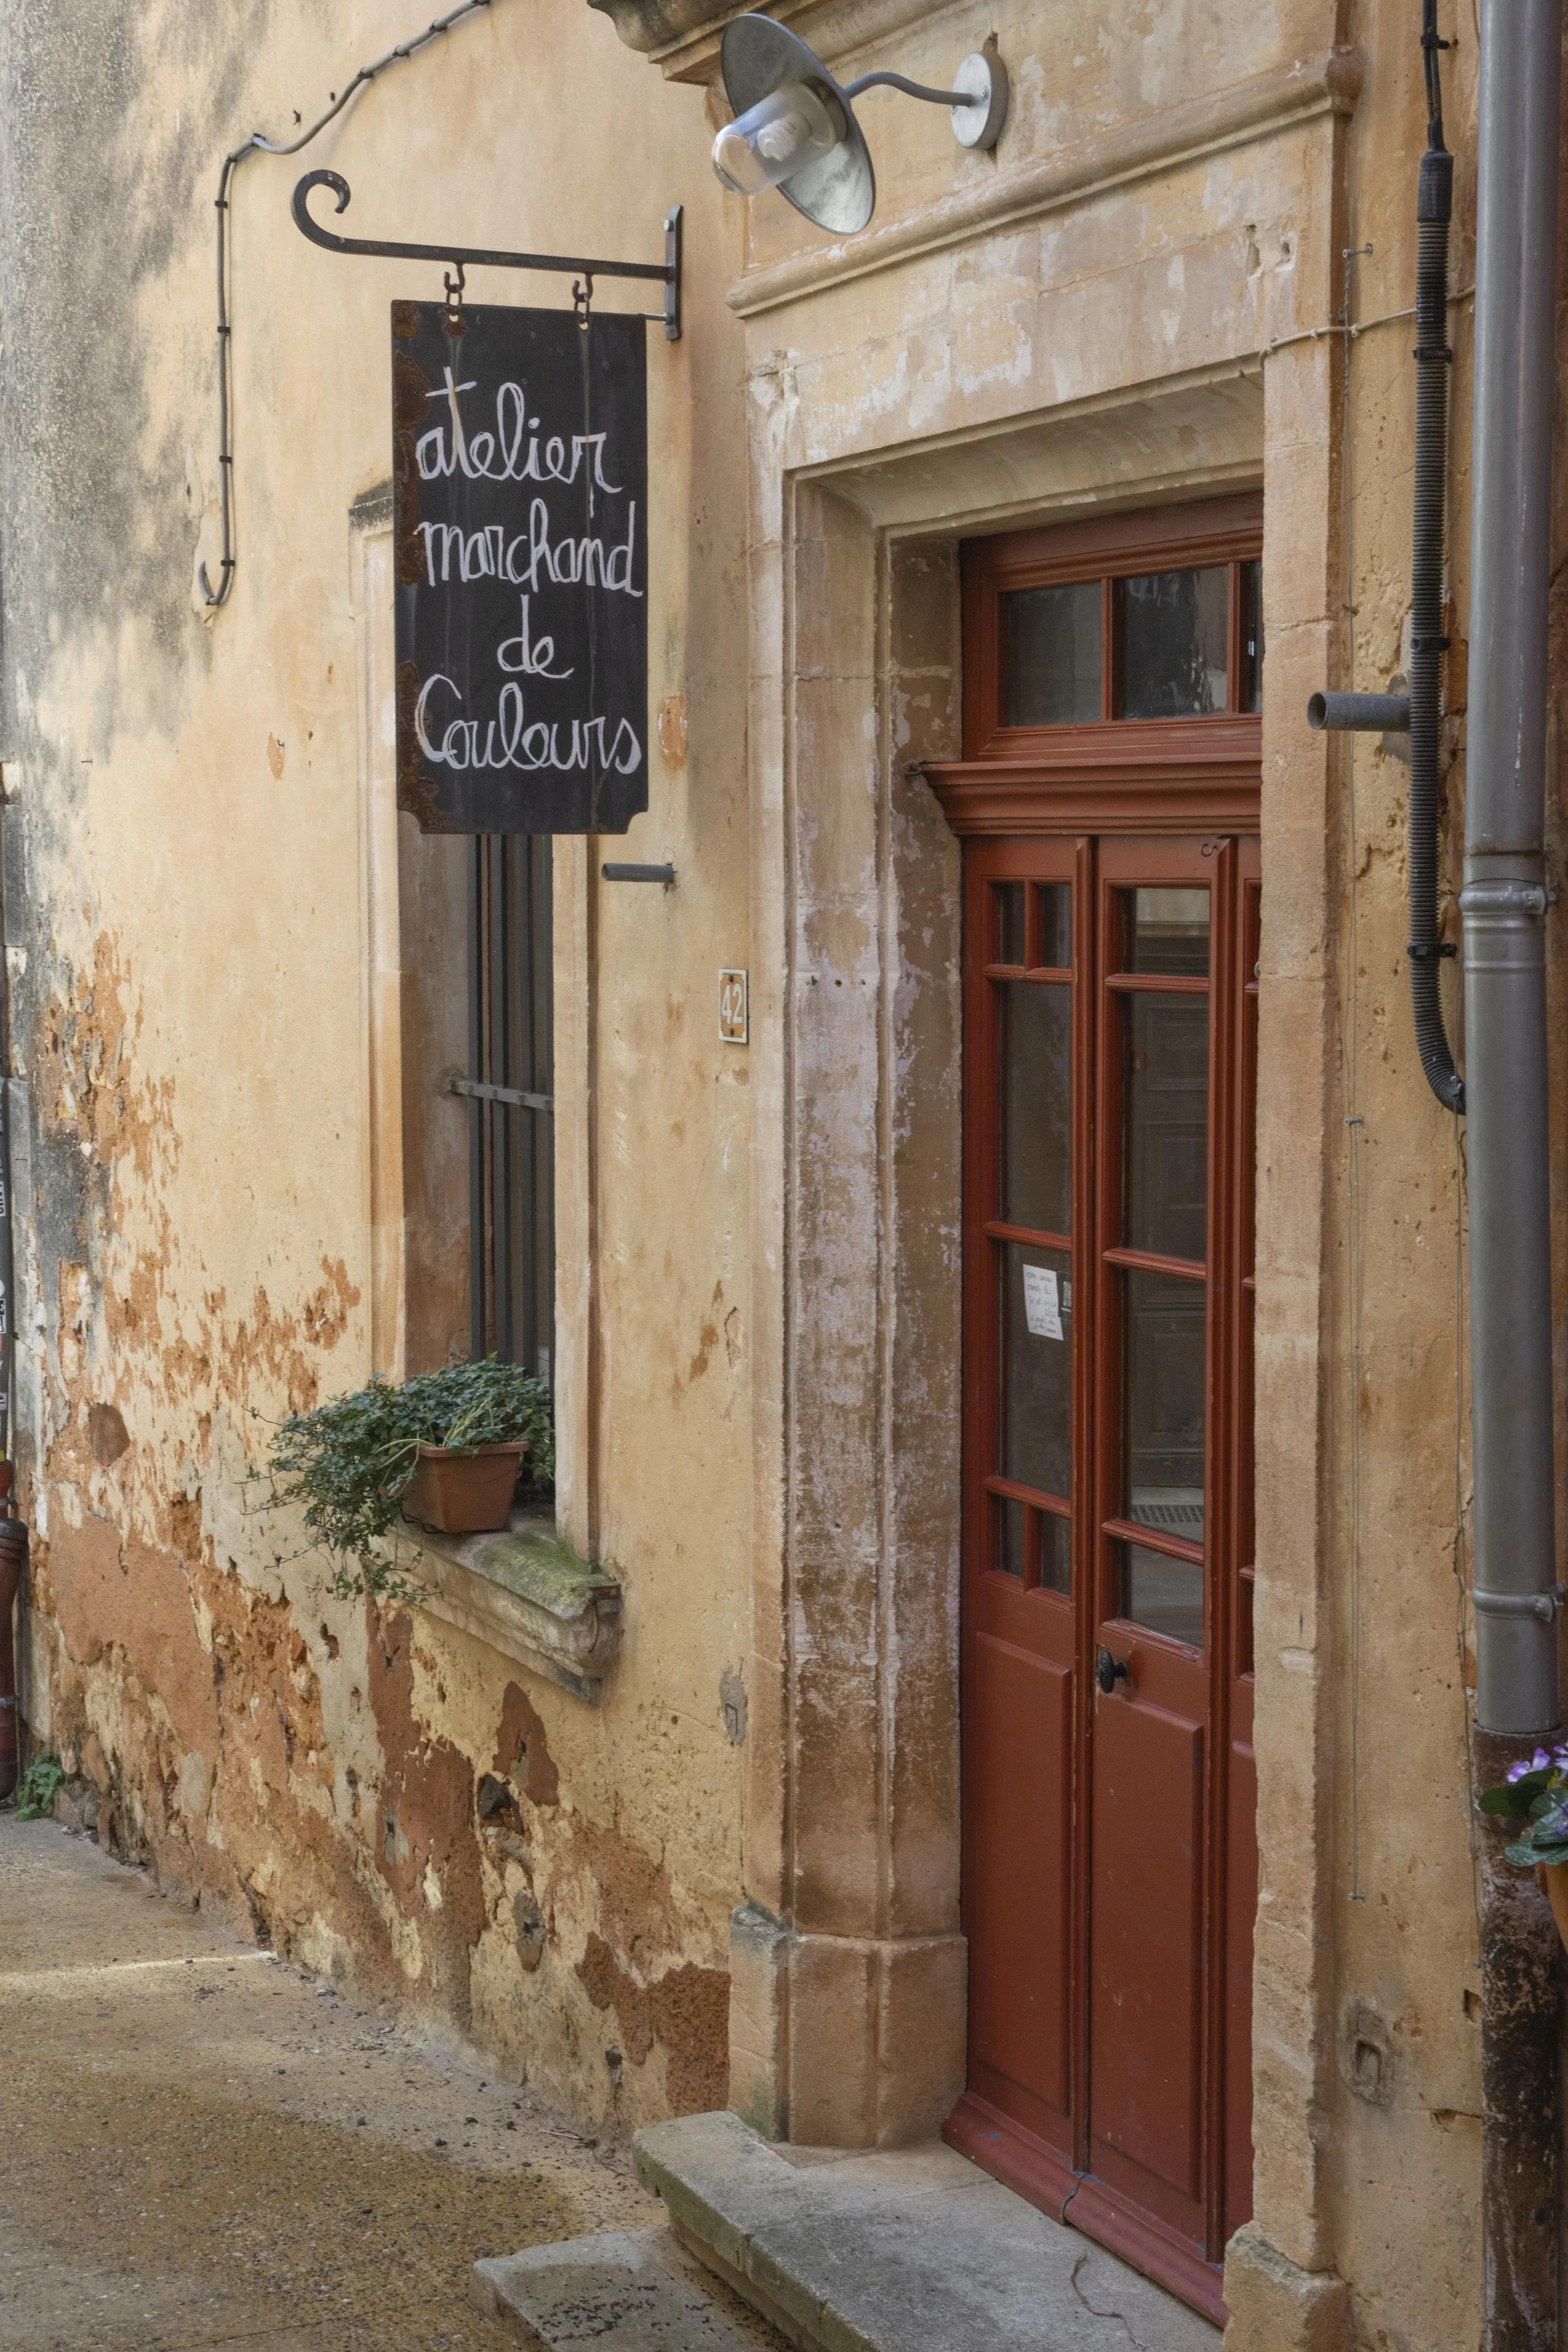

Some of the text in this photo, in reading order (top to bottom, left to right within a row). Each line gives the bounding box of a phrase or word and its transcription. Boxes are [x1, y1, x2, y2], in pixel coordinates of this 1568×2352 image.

[415, 367, 623, 494] atelier
[413, 497, 644, 597] marchand
[497, 595, 575, 679] de
[415, 674, 642, 774] Couleurs
[721, 983, 743, 1024] 42
